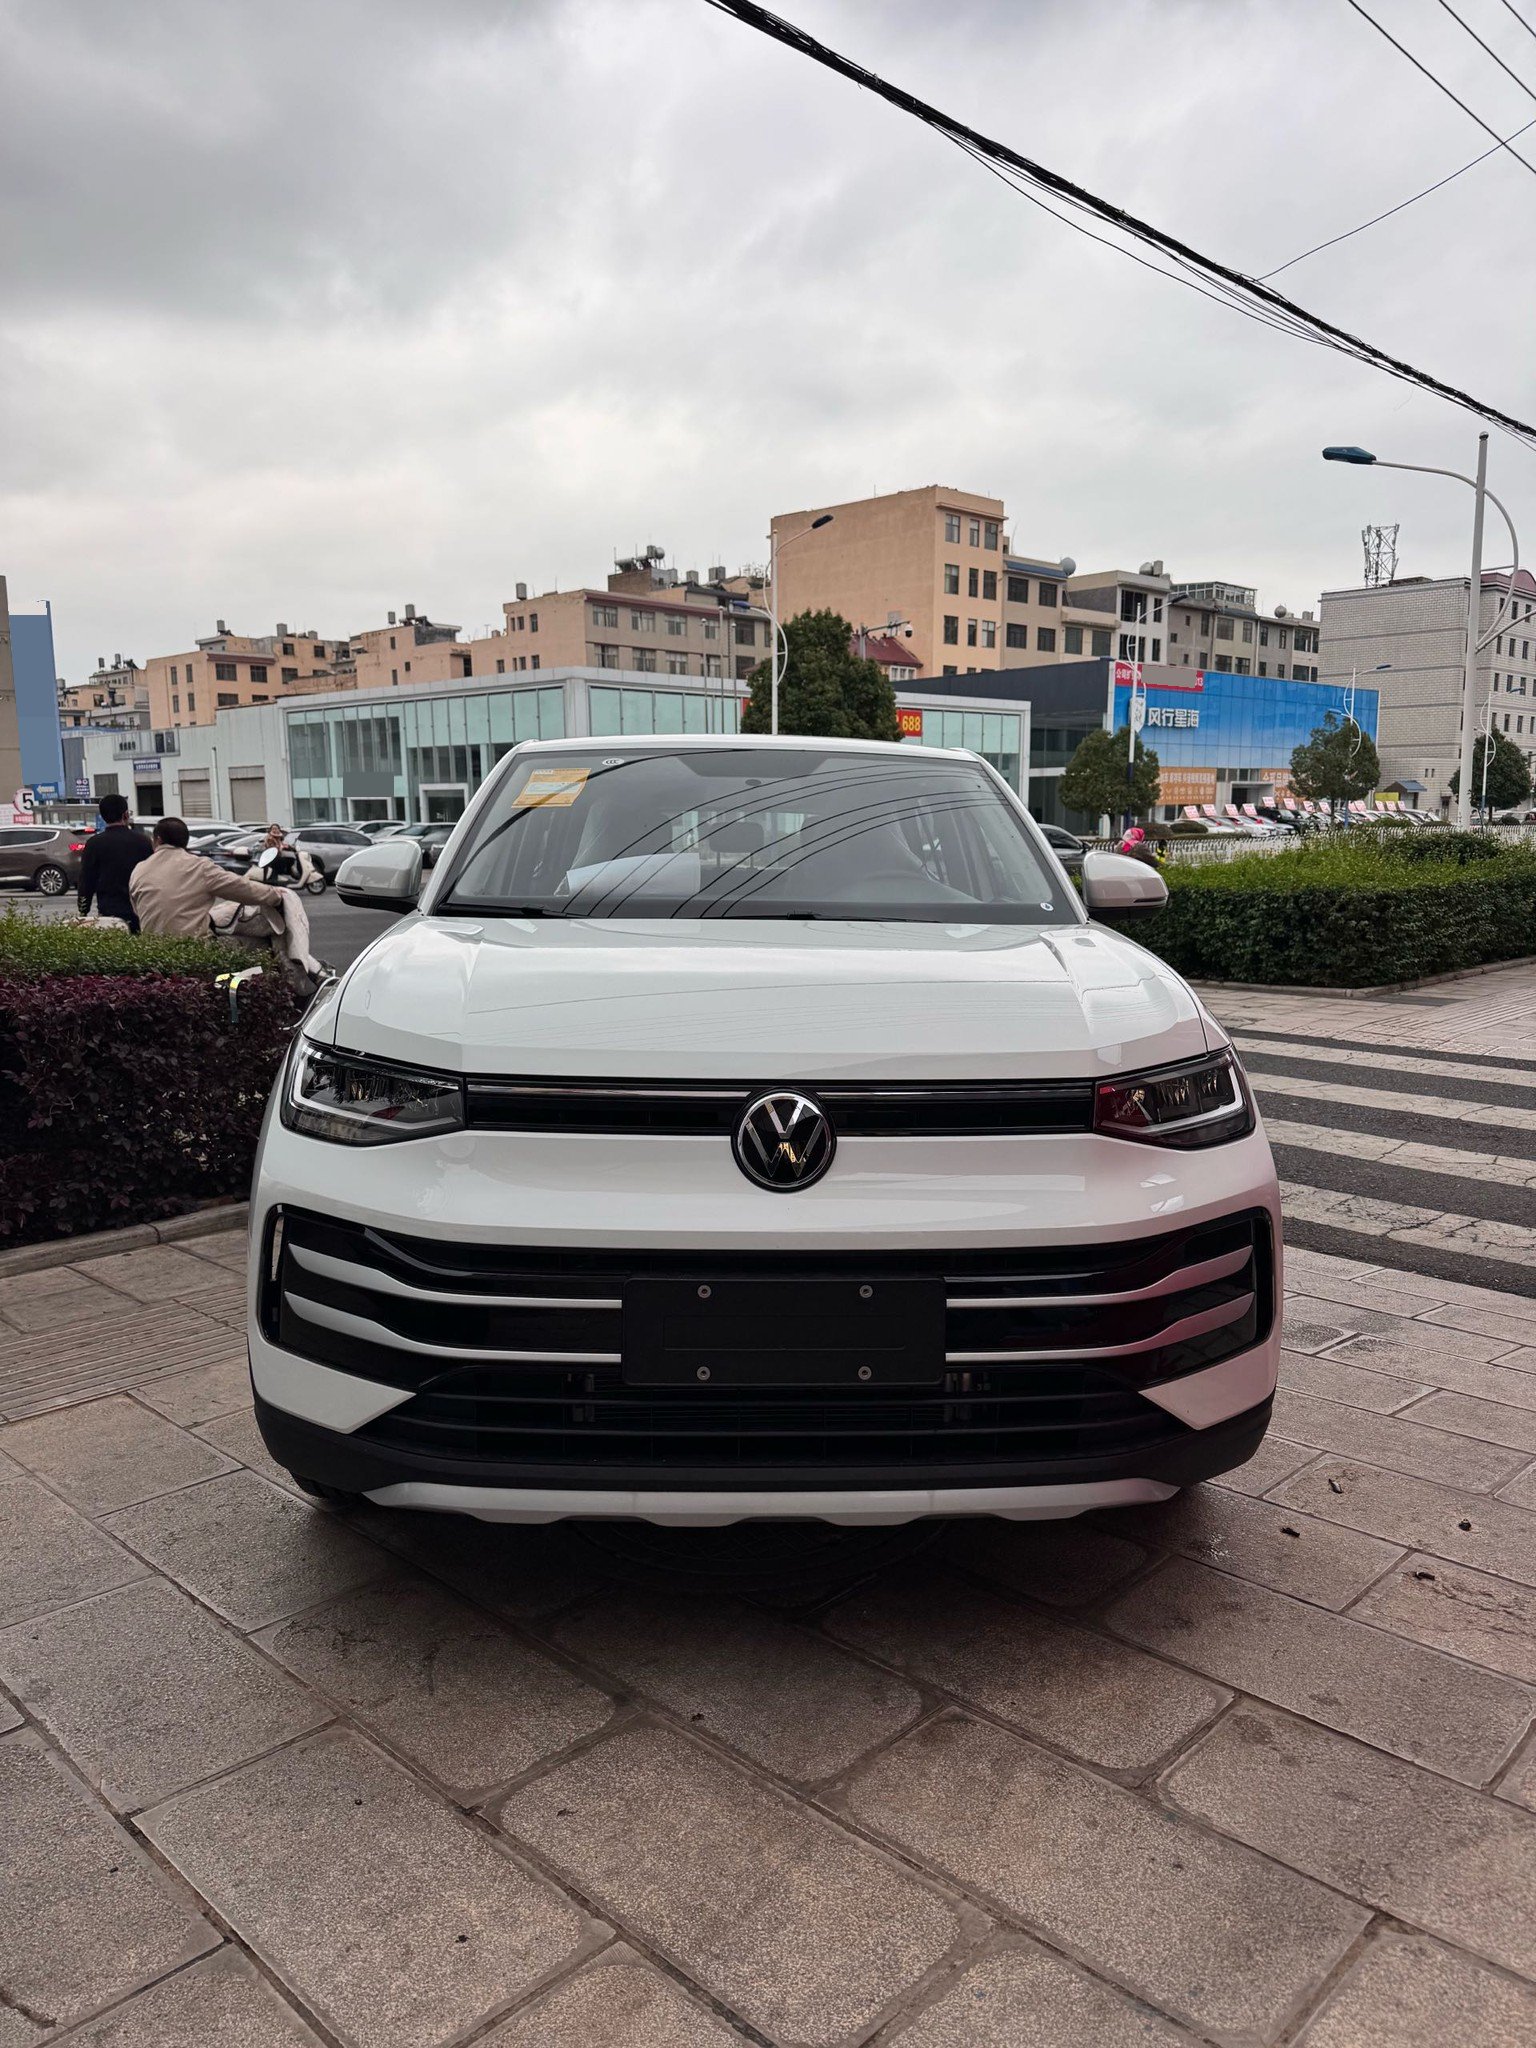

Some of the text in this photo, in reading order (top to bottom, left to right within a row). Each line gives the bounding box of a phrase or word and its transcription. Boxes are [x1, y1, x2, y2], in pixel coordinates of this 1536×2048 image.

[902, 715, 921, 731] 688
[1148, 707, 1199, 728] 风行星海
[22, 792, 34, 811] 5
